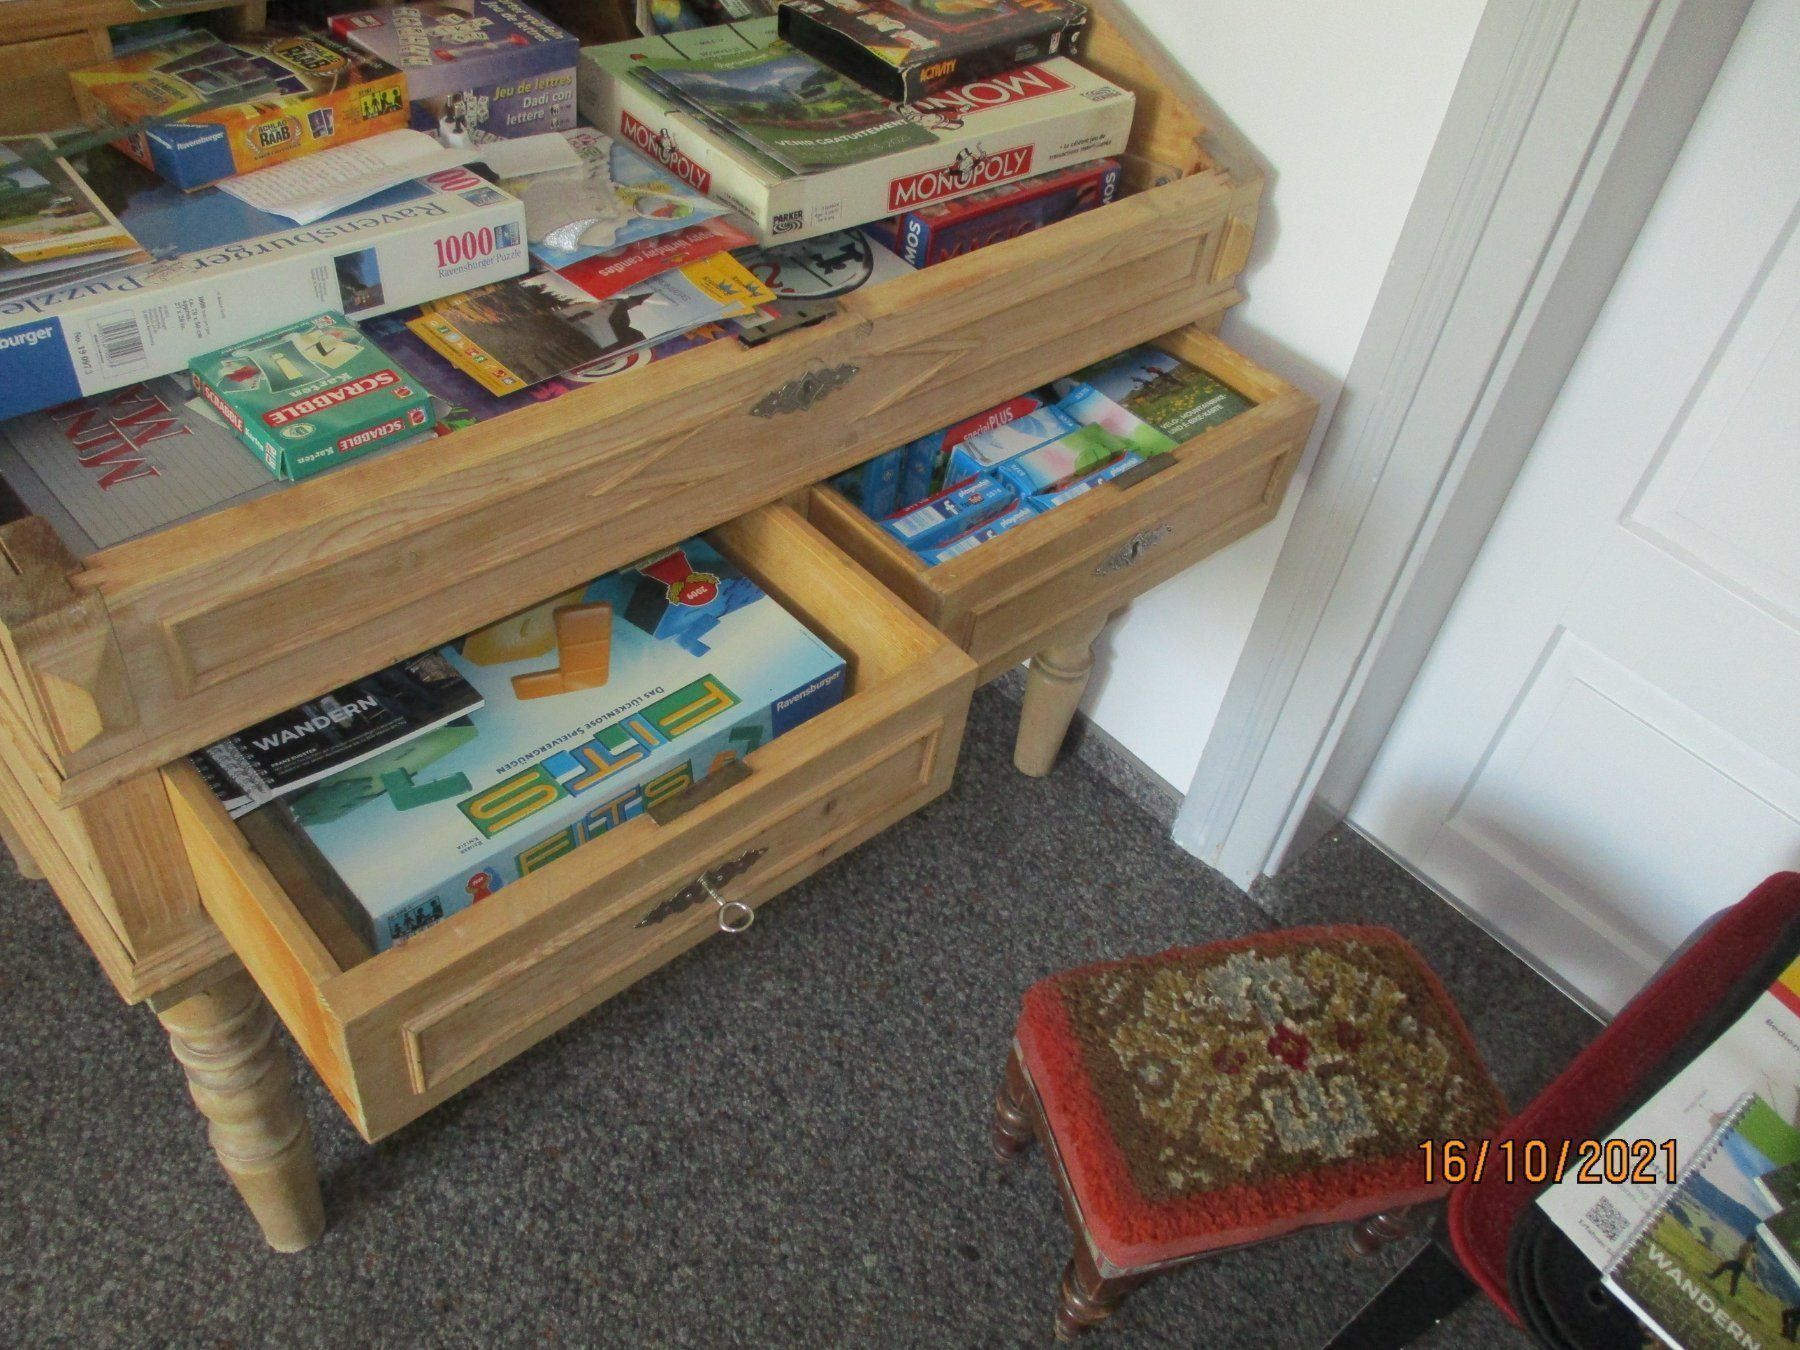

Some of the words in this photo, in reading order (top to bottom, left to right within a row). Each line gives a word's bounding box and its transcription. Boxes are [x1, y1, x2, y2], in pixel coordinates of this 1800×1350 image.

[920, 59, 957, 83] ACTIVITY
[495, 86, 514, 101] Jeu
[518, 82, 531, 95] de
[534, 74, 572, 91] lettres
[523, 94, 549, 109] Dadi
[552, 90, 573, 102] con
[506, 110, 545, 126] lettere
[818, 119, 908, 147] GRATUITEMENT
[176, 132, 225, 151] Ravensburger
[259, 127, 291, 147] RAAB
[624, 117, 706, 188] MONOPOLY
[894, 150, 1028, 205] MONOPOLY
[773, 211, 803, 224] PARKER
[188, 201, 450, 270] Ravensburger
[433, 227, 493, 270] 1000
[438, 255, 495, 279] Ravensburger
[496, 247, 522, 263] Puzzle
[598, 257, 643, 278] candles
[1, 276, 144, 316] Puzzle
[269, 373, 394, 425] SCRABBLE
[288, 373, 352, 398] Karten
[204, 387, 244, 431] SCRABBLE
[340, 420, 402, 450] SCRABBLE
[297, 446, 334, 464] Karten
[685, 583, 708, 601] 2009
[775, 670, 842, 713] Ravensburger
[253, 694, 379, 752] WANDERN
[470, 680, 736, 834] FITS
[1648, 1246, 1761, 1350] WANDERN
